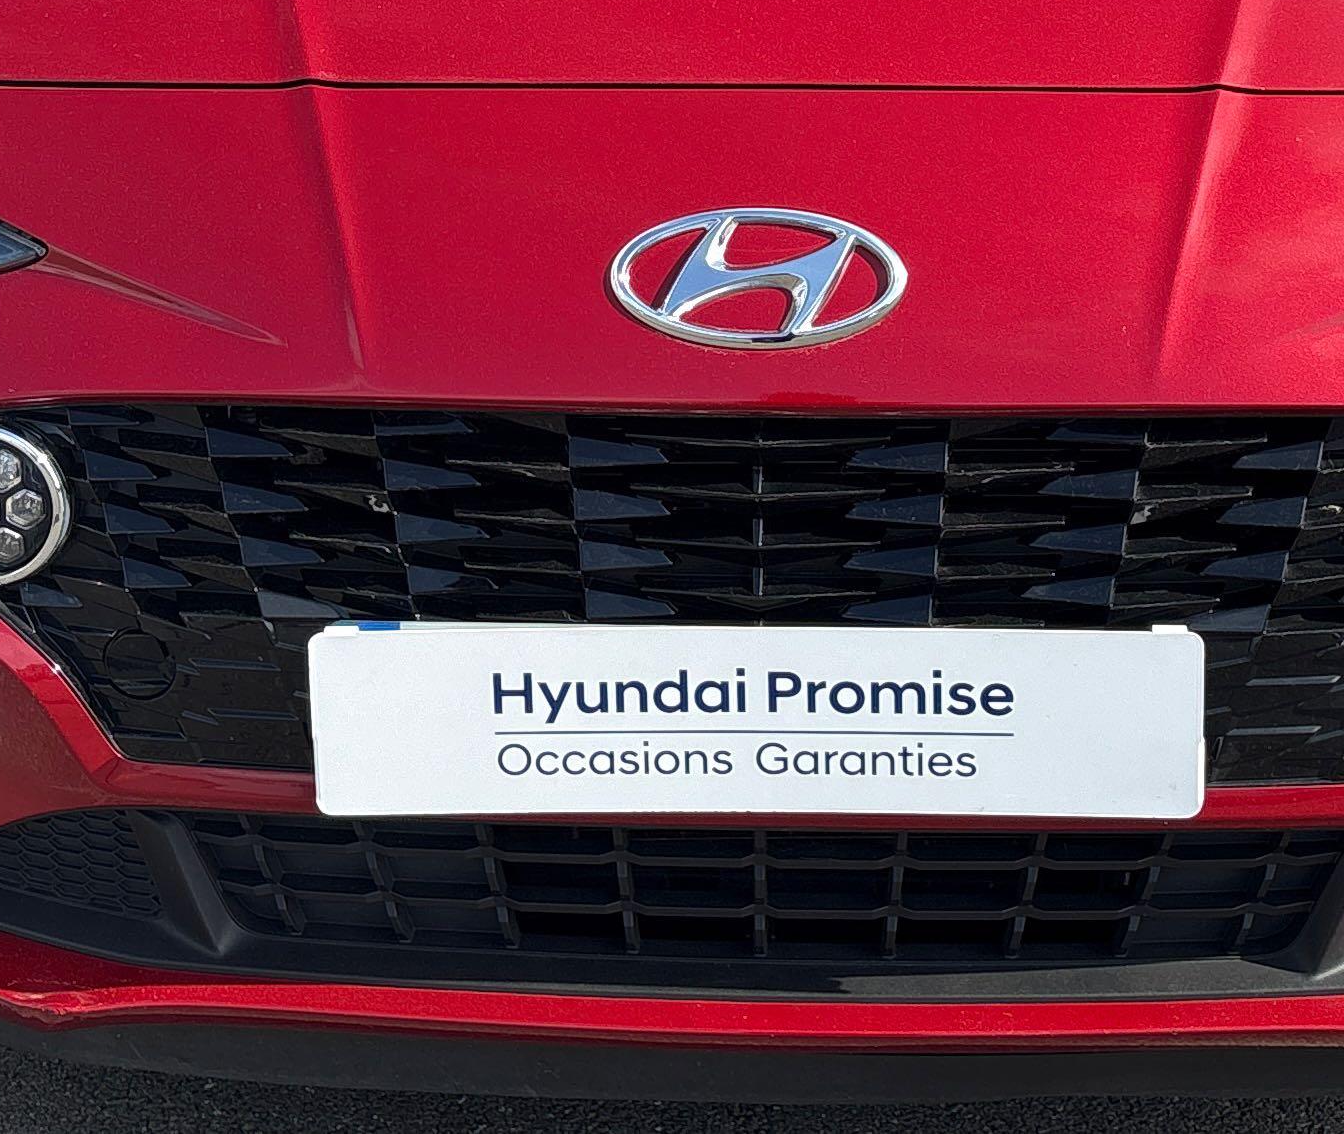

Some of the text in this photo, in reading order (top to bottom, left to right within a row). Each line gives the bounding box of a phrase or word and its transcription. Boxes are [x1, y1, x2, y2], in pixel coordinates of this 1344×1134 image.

[491, 667, 1014, 724] Hyundai Promise
[496, 740, 977, 777] Occasions Garanties
